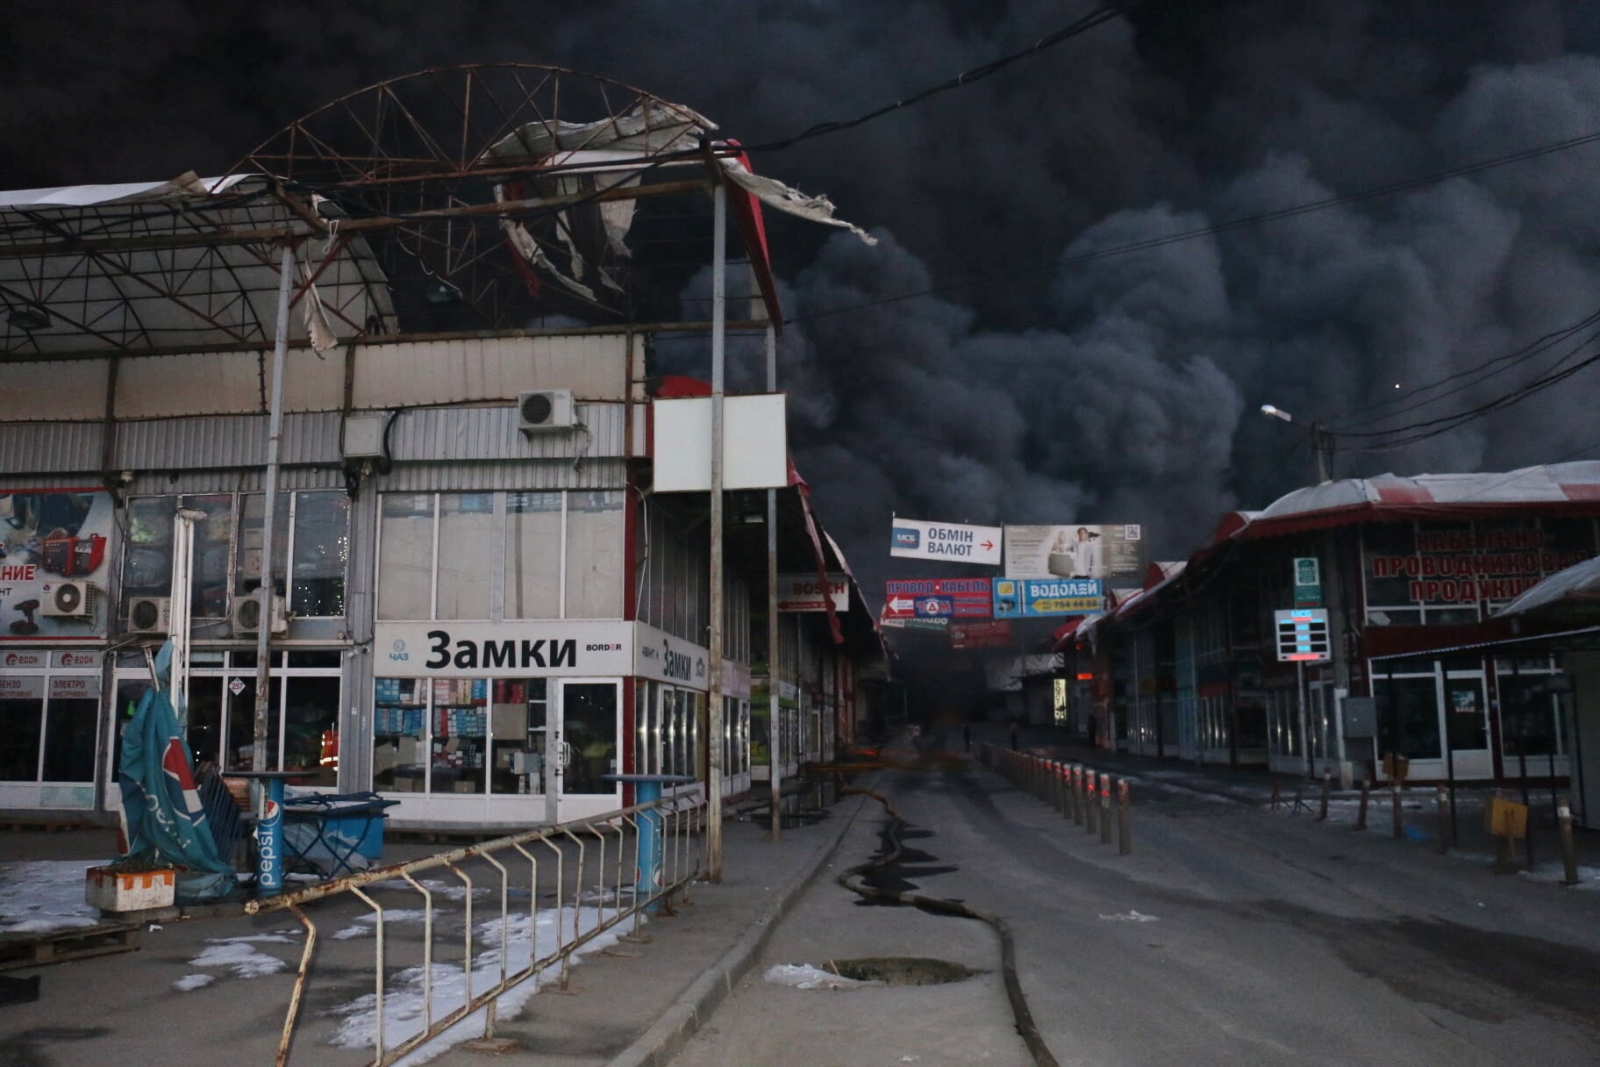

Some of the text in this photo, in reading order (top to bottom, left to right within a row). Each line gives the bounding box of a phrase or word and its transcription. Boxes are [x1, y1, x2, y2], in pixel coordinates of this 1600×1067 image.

[928, 528, 973, 543] ОБМІН
[927, 542, 973, 556] ВАЛЮТ
[0, 565, 36, 581] НИЕ
[1030, 579, 1098, 598] ВОДОЛЕЙ
[425, 630, 577, 669] Замки
[586, 643, 623, 651] BORDER
[389, 653, 409, 661] ЧАЗ
[663, 638, 691, 681] Замки
[53, 680, 86, 688] ЭЛЕКТРО
[259, 829, 277, 886] pepsi
